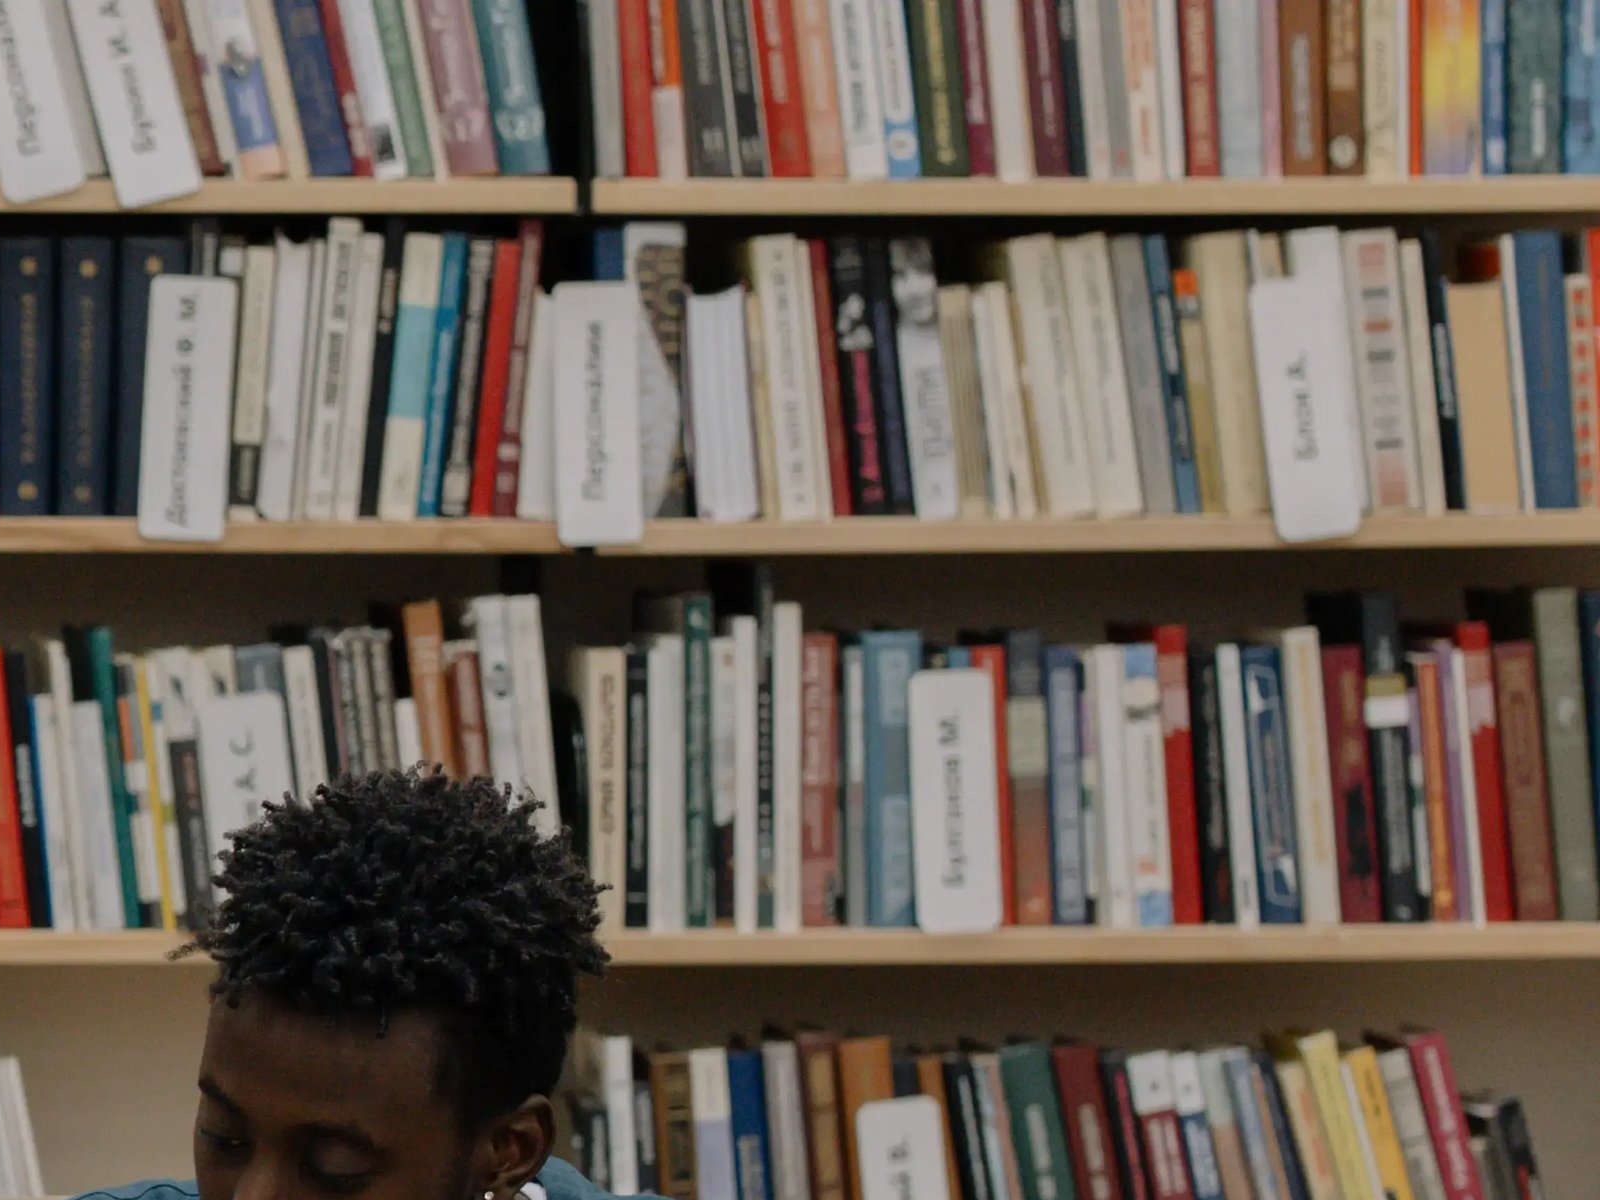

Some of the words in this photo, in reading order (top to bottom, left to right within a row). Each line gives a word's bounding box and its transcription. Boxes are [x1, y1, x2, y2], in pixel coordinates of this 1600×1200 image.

[166, 366, 192, 529] Достоевский
[1293, 388, 1319, 463] Блок
[941, 754, 968, 890] Булгаков
